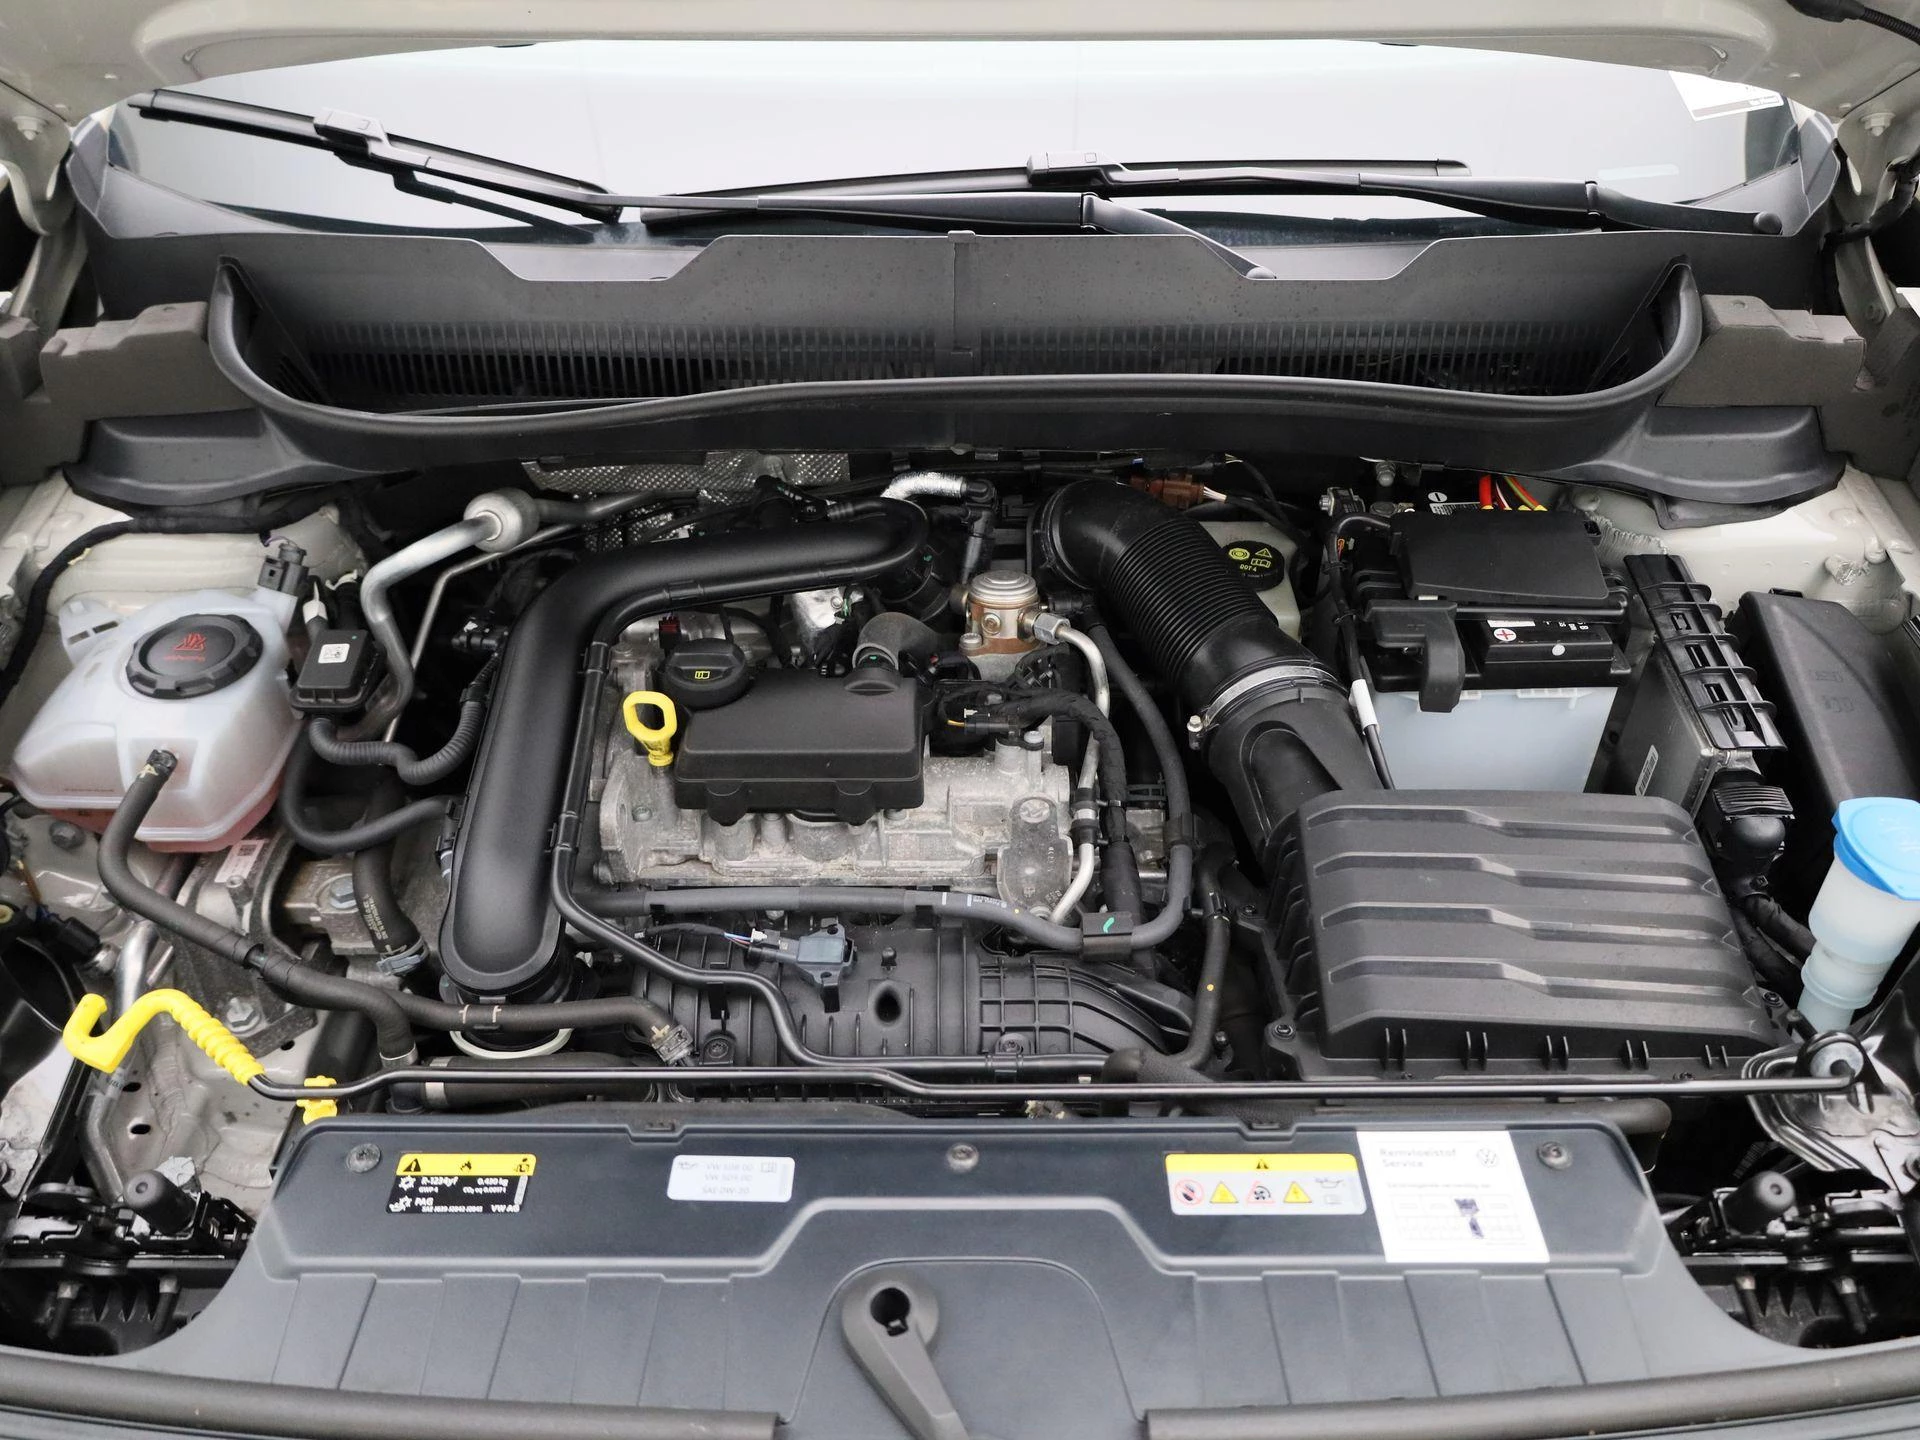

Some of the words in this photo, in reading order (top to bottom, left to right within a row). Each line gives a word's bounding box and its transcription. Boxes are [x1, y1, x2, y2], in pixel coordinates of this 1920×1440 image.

[1382, 1158, 1424, 1168] Service
[498, 1177, 509, 1187] kg
[415, 1197, 434, 1206] PAG
